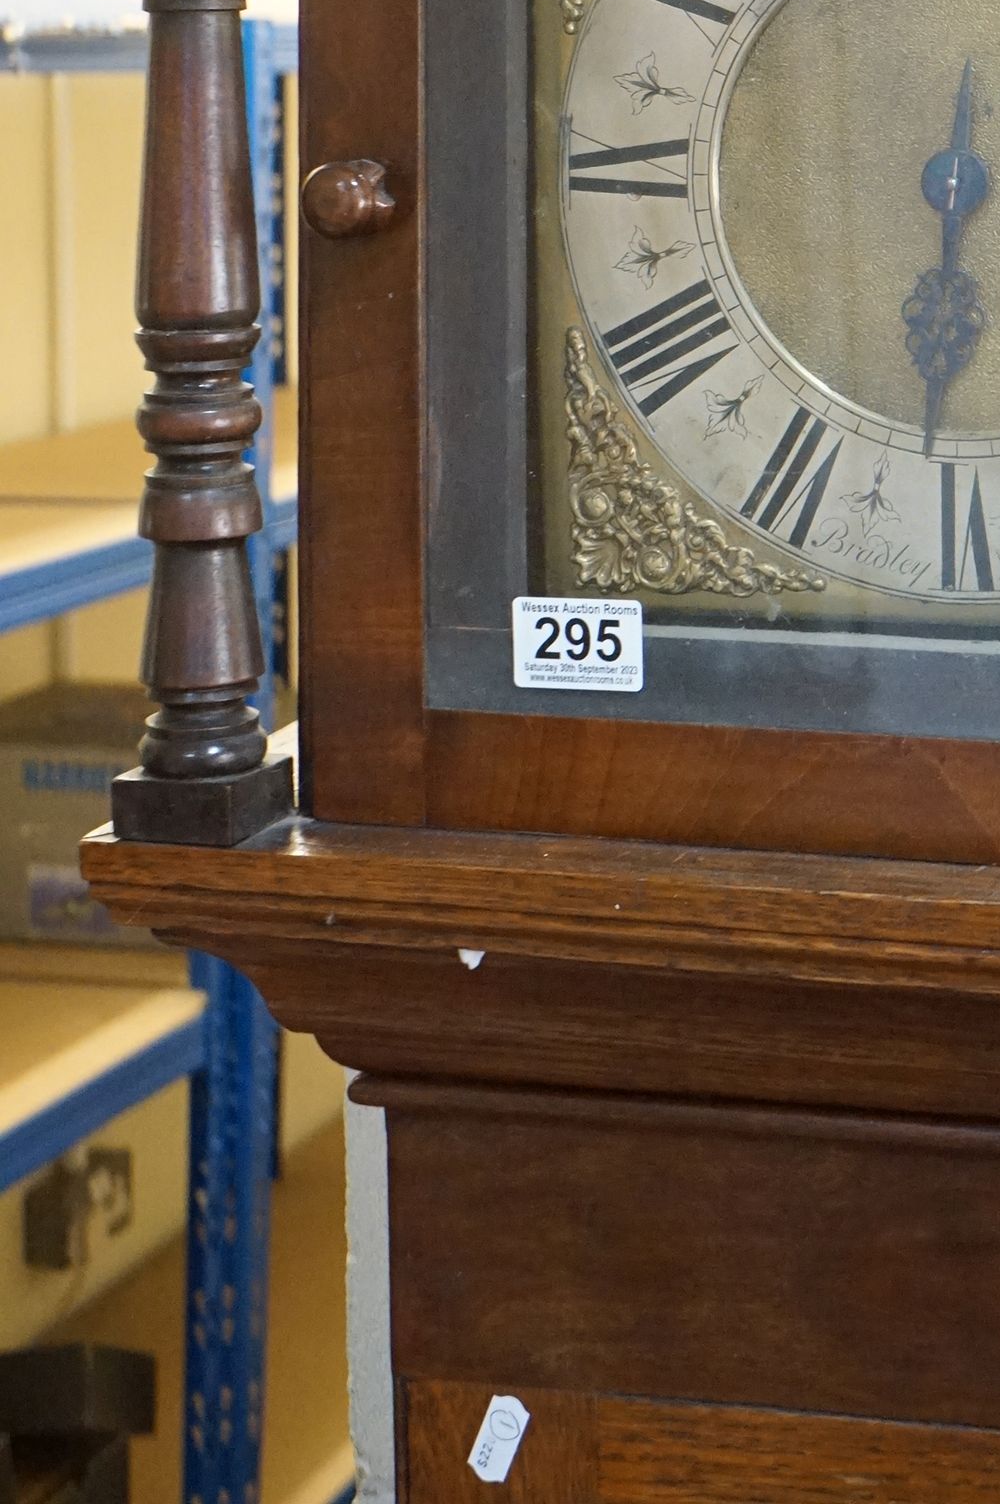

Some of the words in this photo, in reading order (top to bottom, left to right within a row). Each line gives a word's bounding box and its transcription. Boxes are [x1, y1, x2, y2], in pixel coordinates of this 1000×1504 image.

[568, 112, 692, 212] IX
[593, 265, 742, 434] VIII
[725, 397, 846, 556] VII
[811, 517, 932, 588] Bradley
[522, 601, 559, 613] Wessex
[562, 602, 600, 615] Auction
[603, 603, 638, 616] Rooms
[535, 616, 622, 662] 295
[524, 662, 558, 674] Saturday
[578, 663, 619, 675] September
